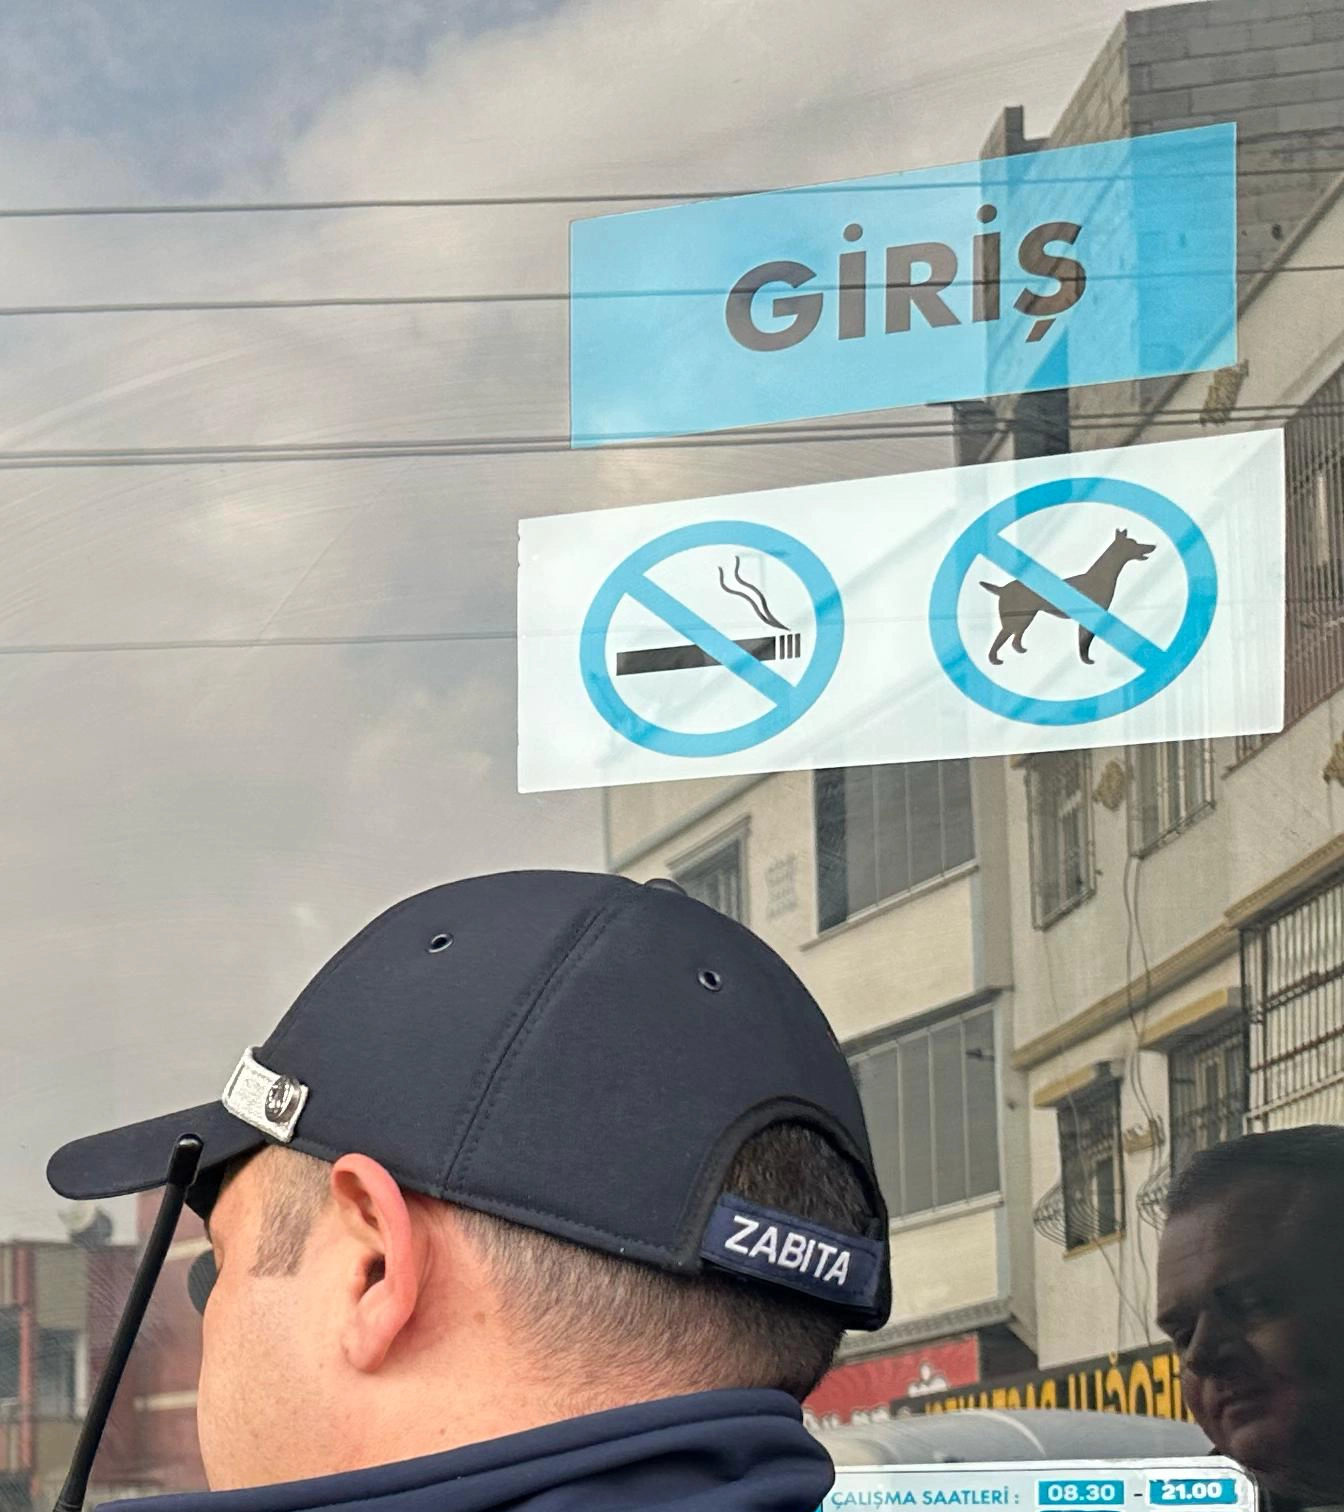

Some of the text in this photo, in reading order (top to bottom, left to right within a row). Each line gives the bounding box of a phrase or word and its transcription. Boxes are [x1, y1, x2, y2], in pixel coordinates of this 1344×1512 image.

[724, 204, 1087, 352] GİRİŞ
[724, 1215, 851, 1286] ZABITA
[831, 1490, 917, 1510] ÇALIŞMA
[922, 1486, 1010, 1505] SAATLERİ
[1047, 1484, 1116, 1501] 08.30
[1161, 1482, 1223, 1500] 21.00
